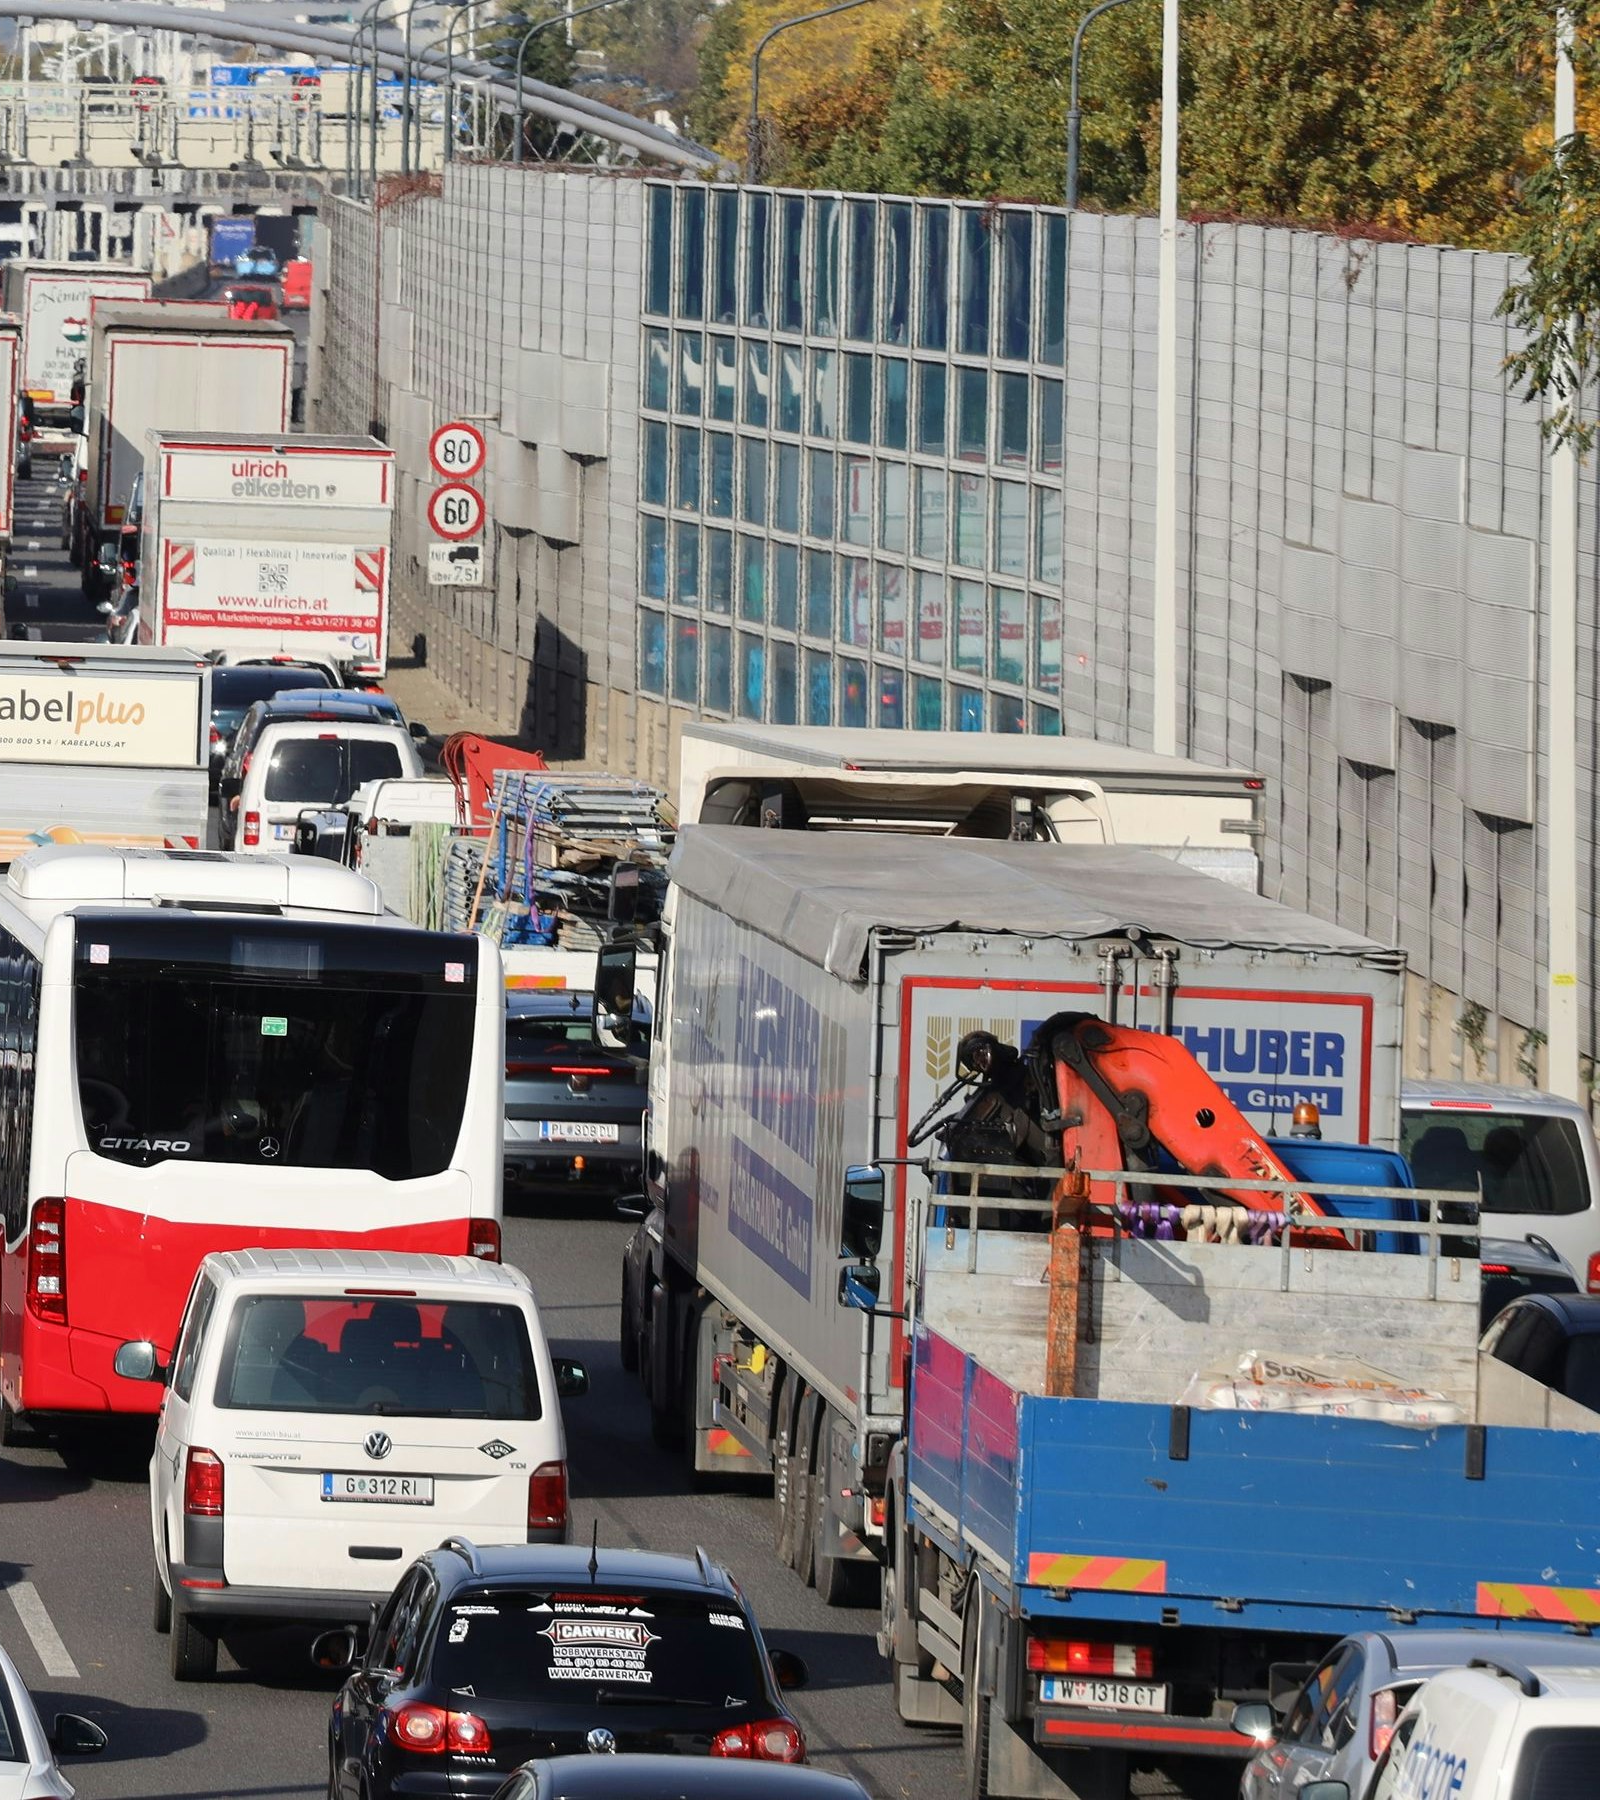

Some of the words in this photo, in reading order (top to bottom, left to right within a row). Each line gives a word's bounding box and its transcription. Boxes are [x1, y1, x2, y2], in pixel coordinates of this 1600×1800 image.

[443, 439, 471, 464] 80
[231, 460, 288, 479] ulrich
[231, 478, 320, 500] etiketten
[443, 498, 470, 525] 60
[217, 595, 329, 611] www.ulrich.at
[60, 740, 127, 748] KABELPLUS.AT
[100, 1136, 191, 1152] CITARO
[732, 1158, 784, 1252] AGRARHANDEL
[235, 1429, 301, 1439] www.granit-bau.at
[228, 1452, 302, 1460] TRANSPORTER
[345, 1477, 355, 1493] G
[368, 1478, 397, 1494] 312
[401, 1480, 417, 1496] RI
[561, 1625, 638, 1641] CARWERK
[553, 1647, 646, 1661] HOBBYWERKSTATT
[554, 1657, 574, 1668] Tel.
[548, 1667, 653, 1683] WWW.CARWERK.AT
[1061, 1679, 1074, 1699] W
[1090, 1682, 1129, 1703] 1318
[1135, 1687, 1157, 1706] GT
